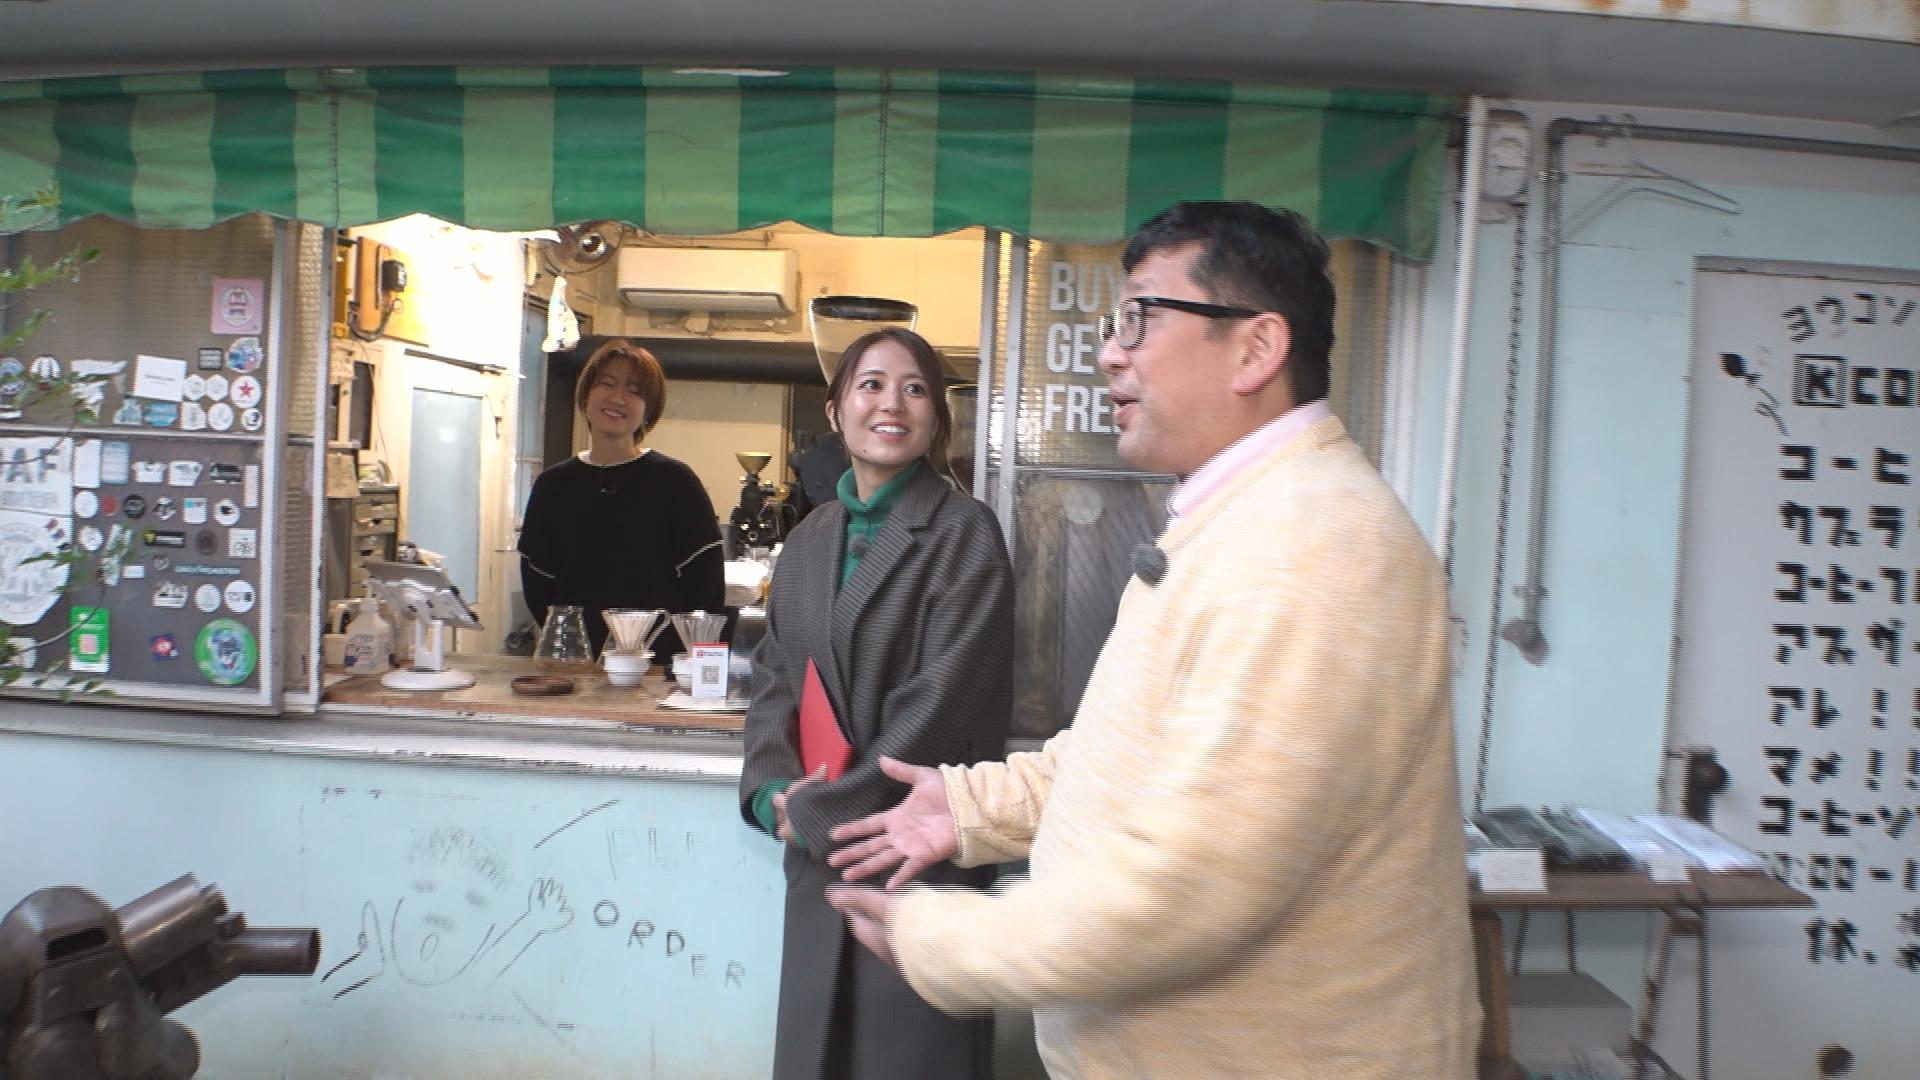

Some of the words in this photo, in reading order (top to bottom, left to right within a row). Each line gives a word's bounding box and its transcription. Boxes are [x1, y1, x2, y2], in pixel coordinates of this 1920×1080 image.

[1780, 292, 1917, 342] ヨウコソ
[1046, 323, 1097, 374] GE
[1043, 383, 1120, 432] FRE
[1851, 367, 1920, 406] CO
[1778, 500, 1920, 546] カフェラ
[1775, 562, 1920, 604] コーヒーフ
[1772, 618, 1920, 666] アフォガ
[1758, 796, 1920, 840] コーヒーソ
[593, 899, 746, 989] ORDER
